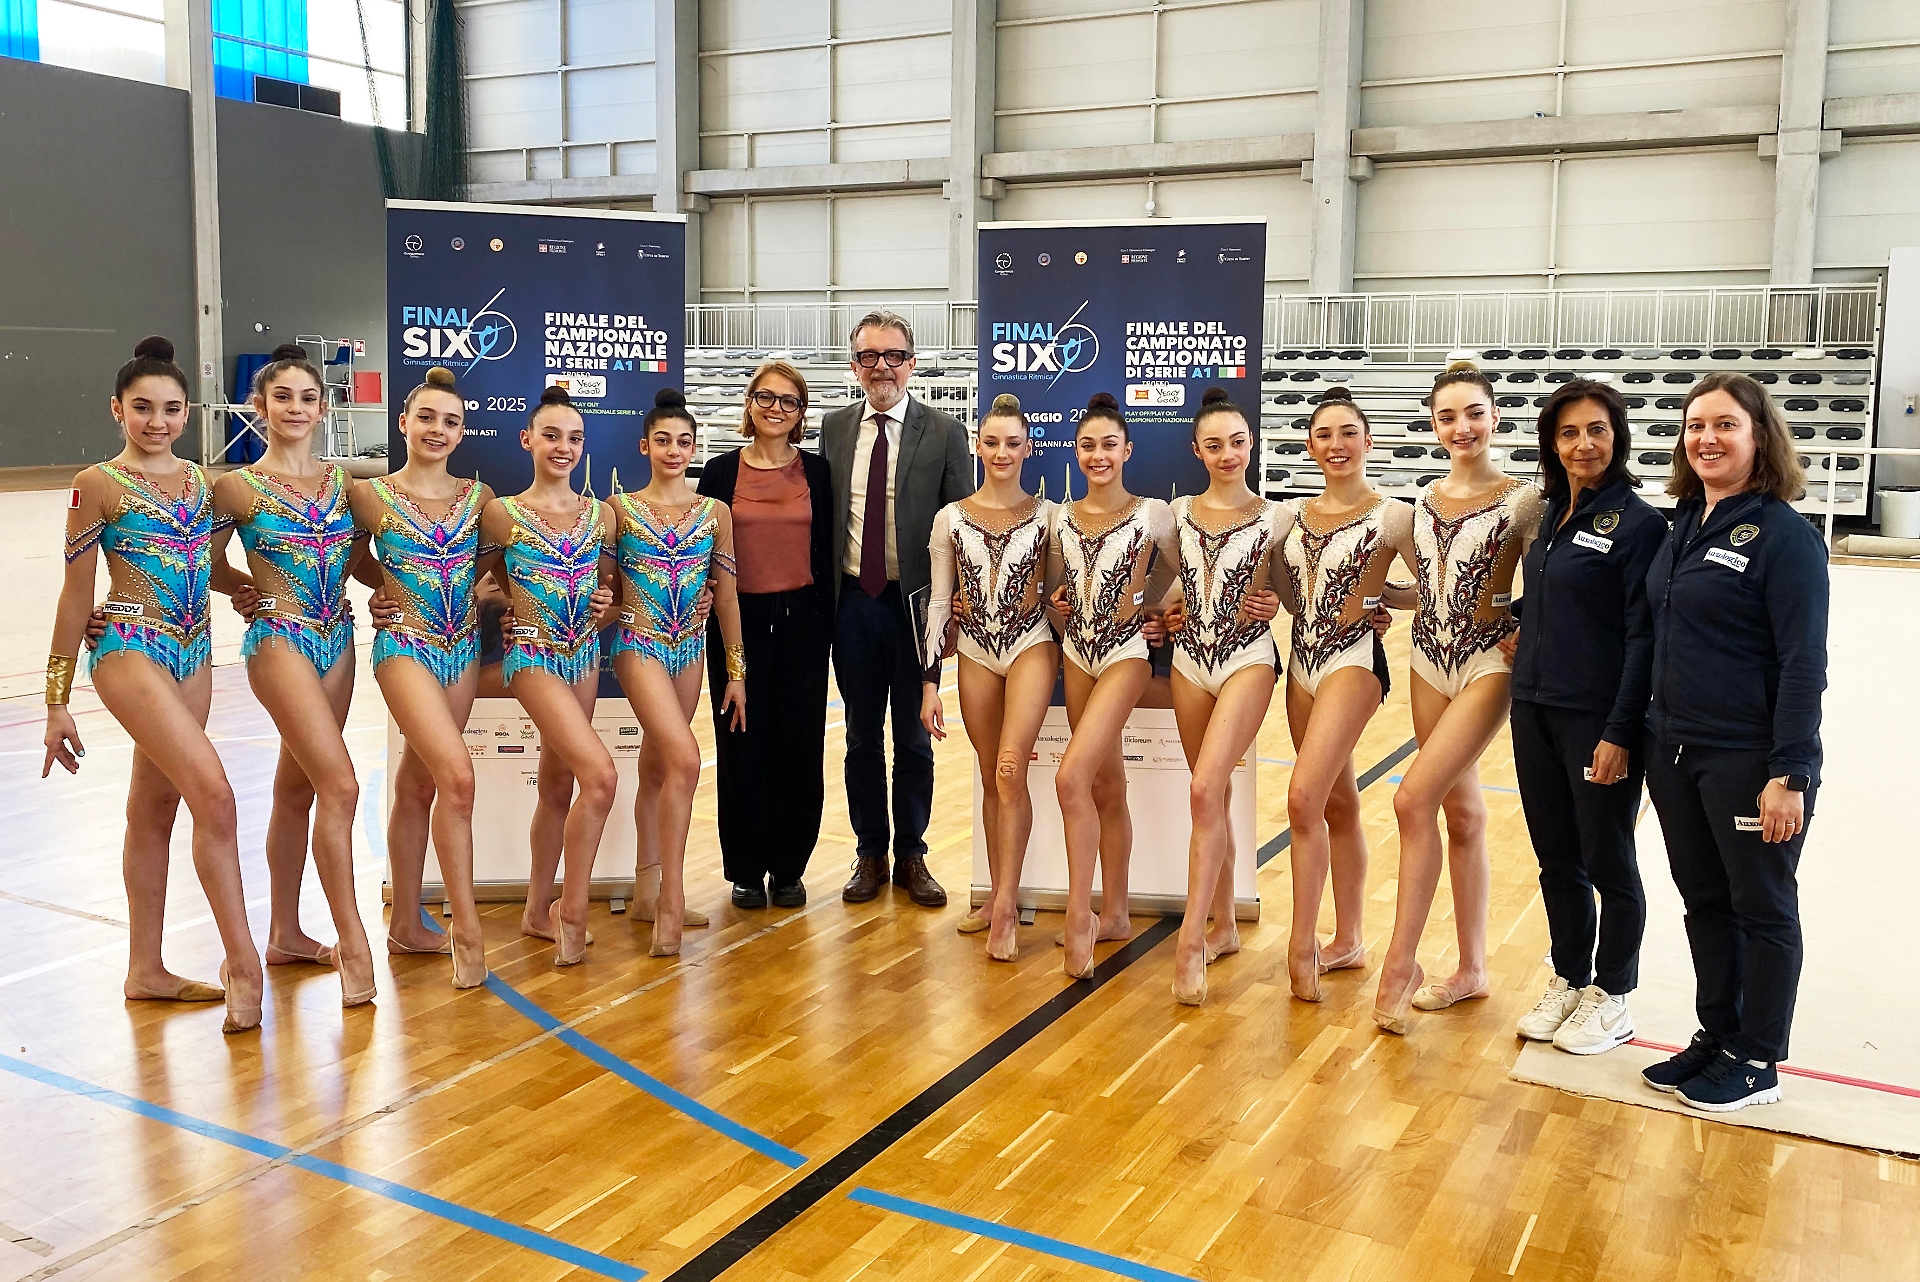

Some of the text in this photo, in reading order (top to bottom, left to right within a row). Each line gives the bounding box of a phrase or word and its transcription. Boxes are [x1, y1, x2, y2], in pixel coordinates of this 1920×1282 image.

[402, 305, 474, 327] FINAL
[545, 312, 648, 329] FINALE DEL
[545, 326, 668, 345] CAMPIONATO
[992, 322, 1058, 341] FINAL
[1126, 321, 1227, 336] FINALE DEL
[402, 327, 475, 359] SIX
[545, 340, 667, 360] NAZIONALE
[1125, 335, 1247, 350] CAMPIONATO
[403, 358, 441, 367] Ginnastica
[545, 356, 633, 371] DI SERIE A1
[991, 342, 1059, 373] SIX
[1125, 349, 1246, 366] NAZIONALE
[991, 373, 1028, 381] Ginnastica
[1125, 366, 1212, 379] DI SERIE A1
[486, 396, 527, 412] 2025
[1034, 440, 1061, 448] GIANNI
